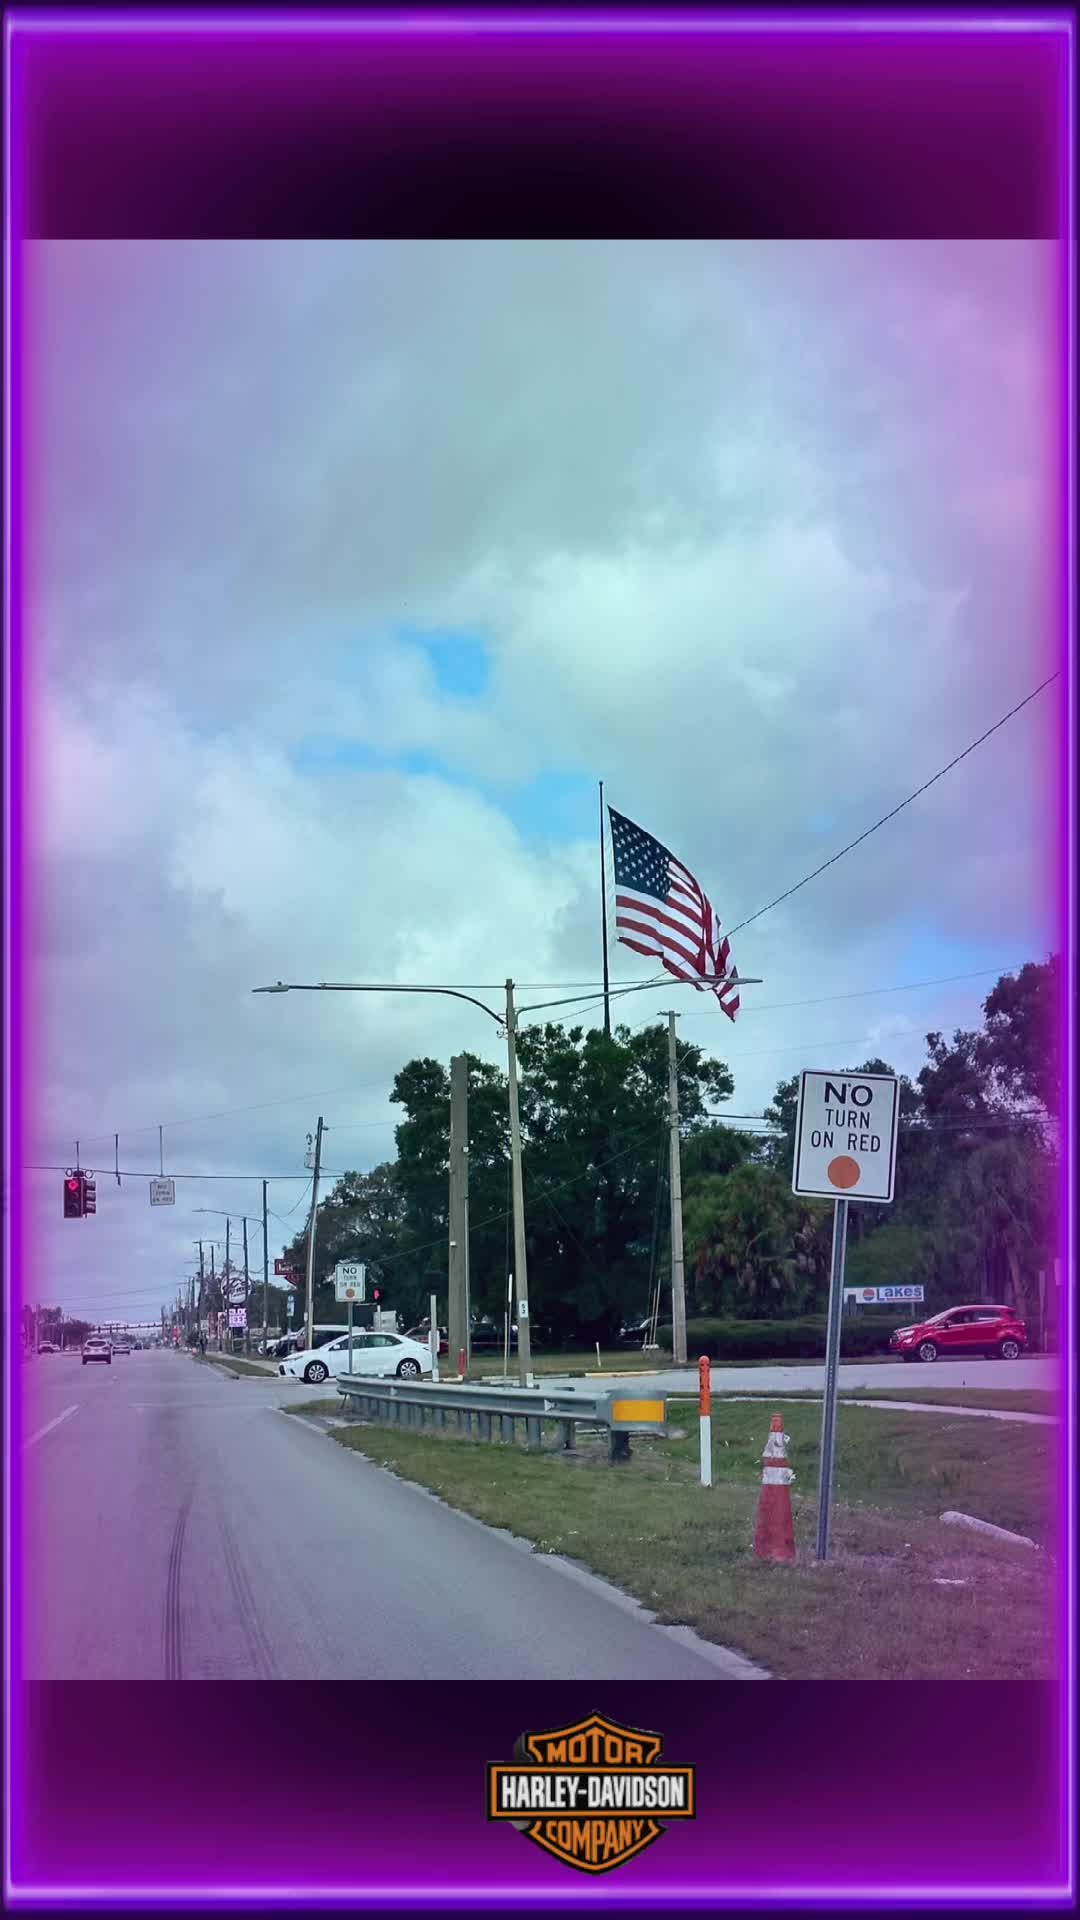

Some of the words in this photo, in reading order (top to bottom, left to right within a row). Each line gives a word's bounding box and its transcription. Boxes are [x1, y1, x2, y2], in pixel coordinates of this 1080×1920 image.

[824, 1081, 873, 1107] NO
[825, 1108, 870, 1129] TURN
[811, 1130, 834, 1148] ON
[847, 1133, 881, 1153] RED
[342, 1267, 358, 1275] NO
[876, 1287, 922, 1301] Lakes
